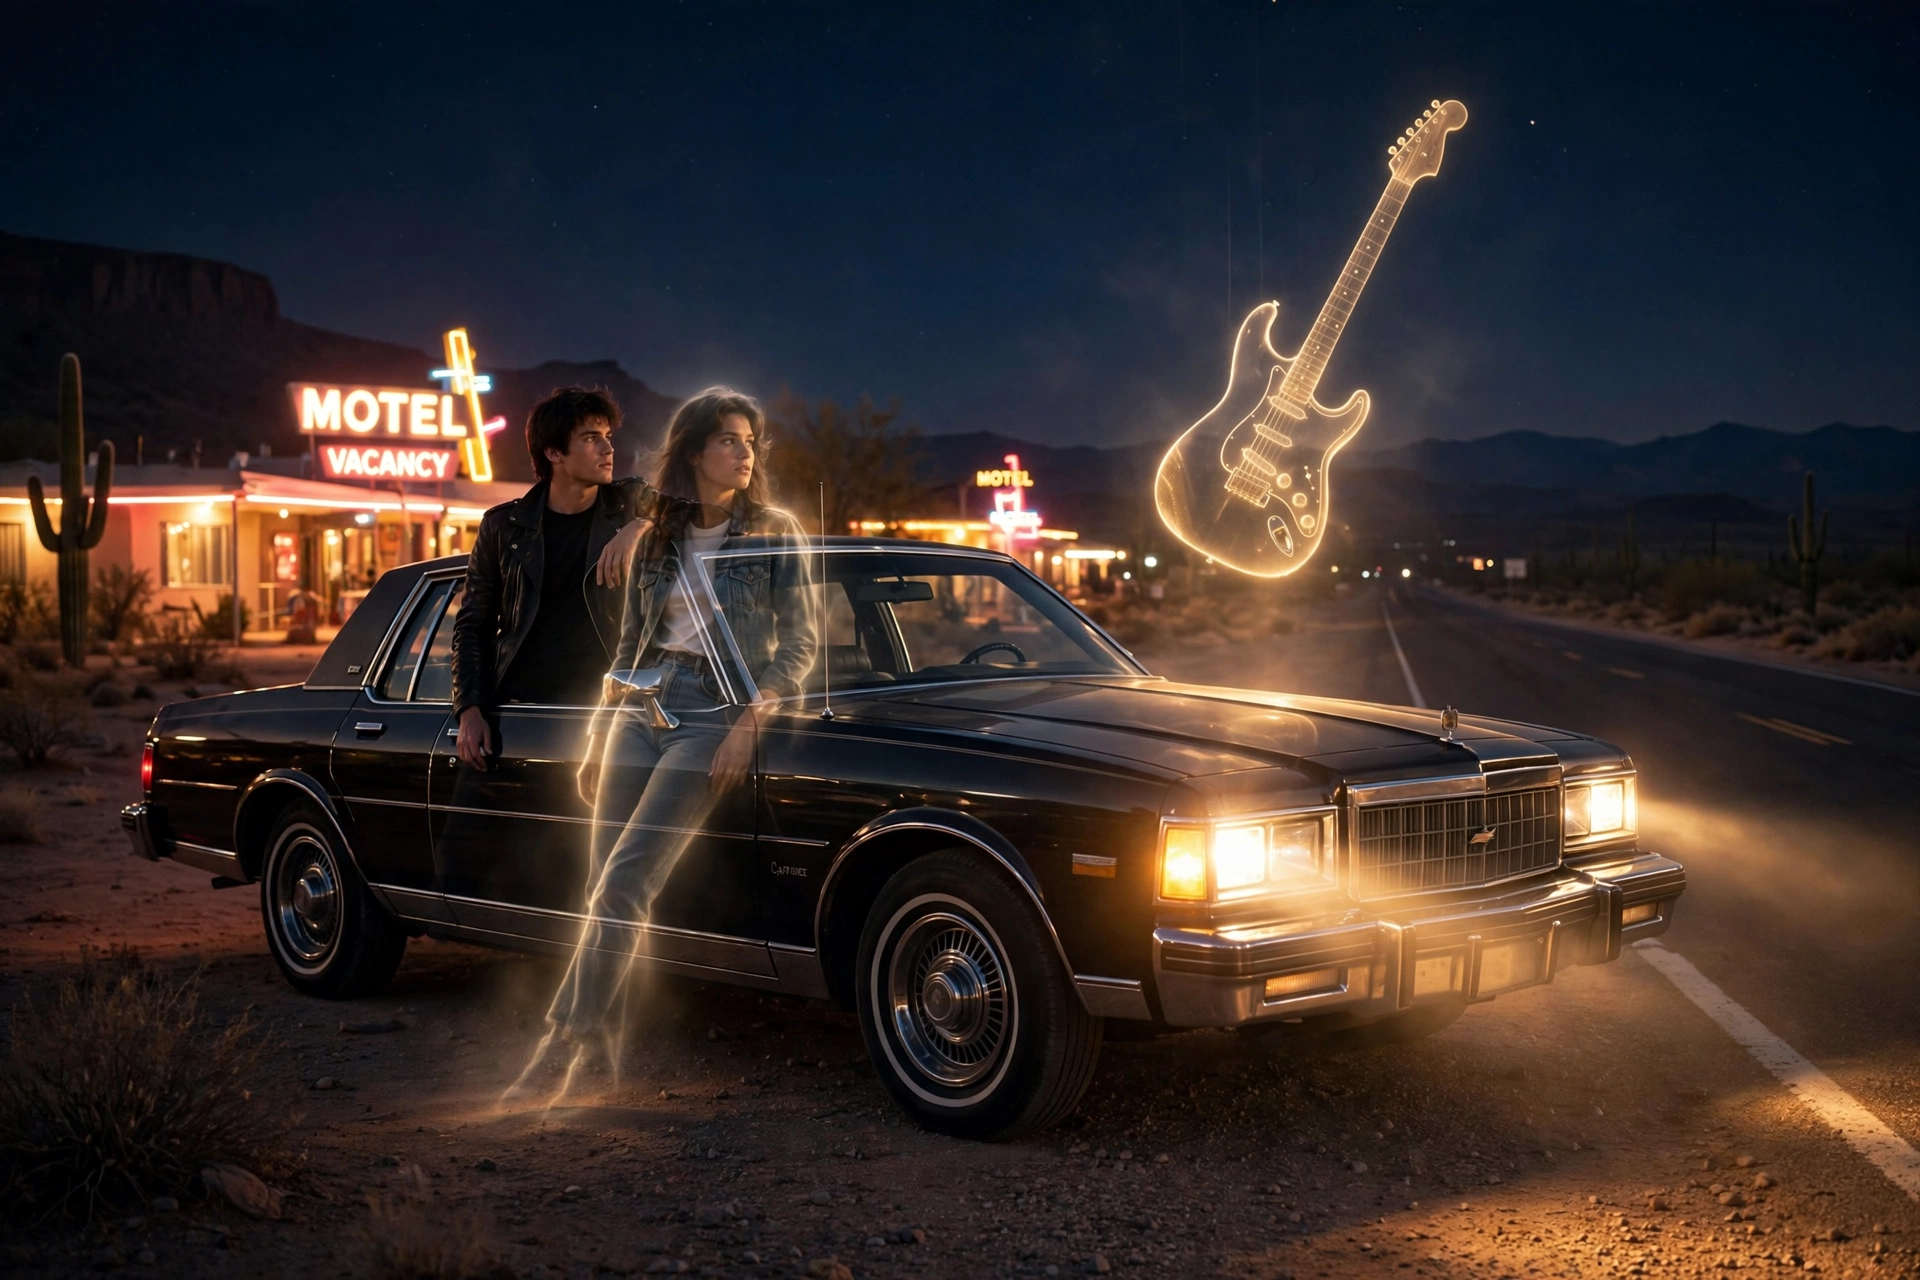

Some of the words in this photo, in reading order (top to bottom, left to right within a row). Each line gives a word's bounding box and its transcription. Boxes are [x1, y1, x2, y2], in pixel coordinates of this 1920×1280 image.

[302, 387, 467, 437] MOTEL
[327, 447, 450, 478] VACANCY
[976, 469, 1034, 487] MOTEL
